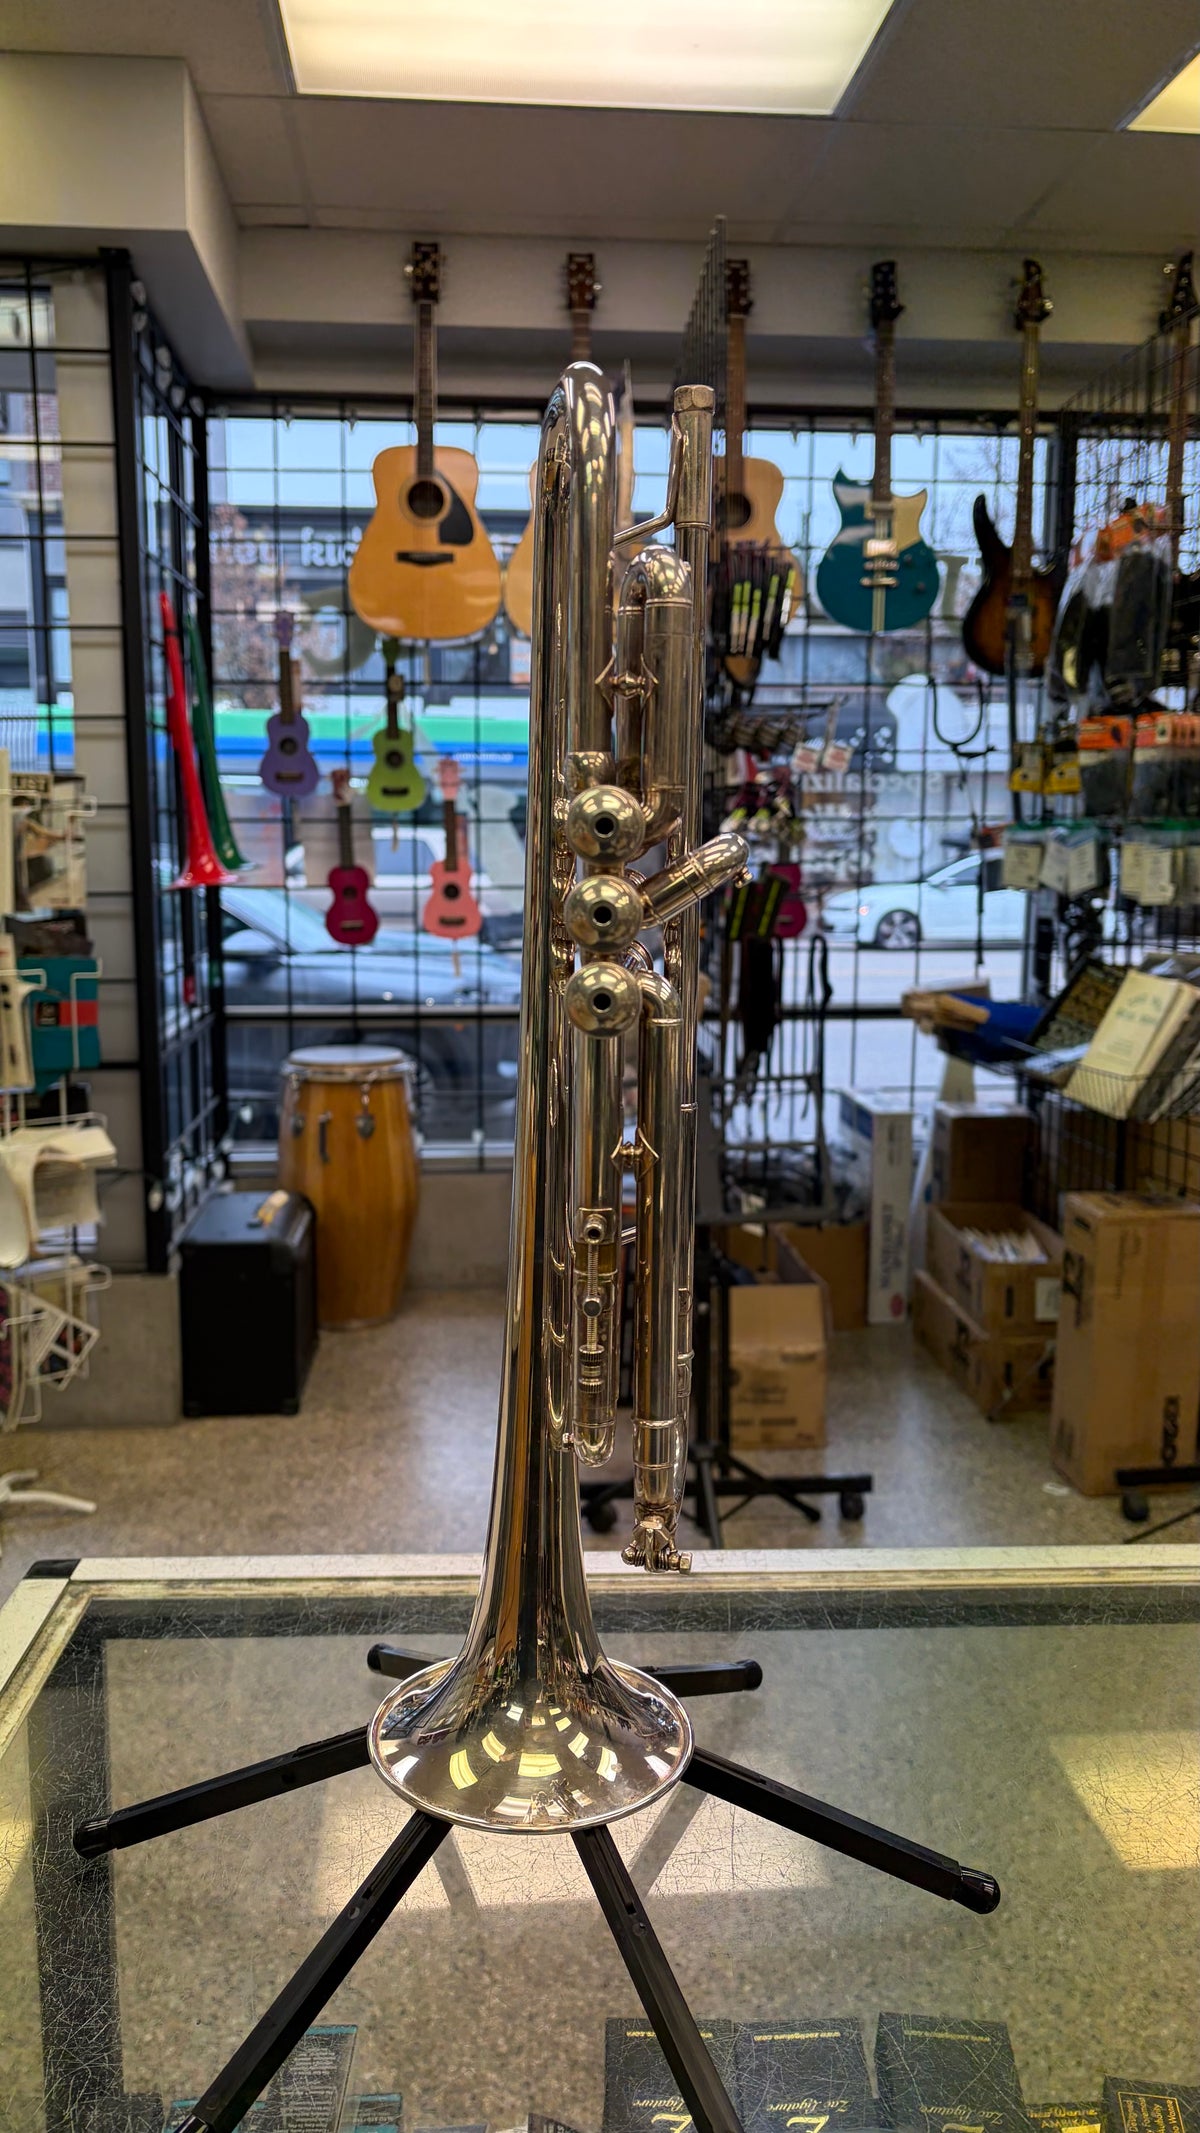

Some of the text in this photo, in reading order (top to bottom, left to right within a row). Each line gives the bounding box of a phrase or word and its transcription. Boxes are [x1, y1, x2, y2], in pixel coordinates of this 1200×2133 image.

[767, 2098, 850, 2114] Zac Ligature
[919, 2105, 1004, 2126] Zac Ligature
